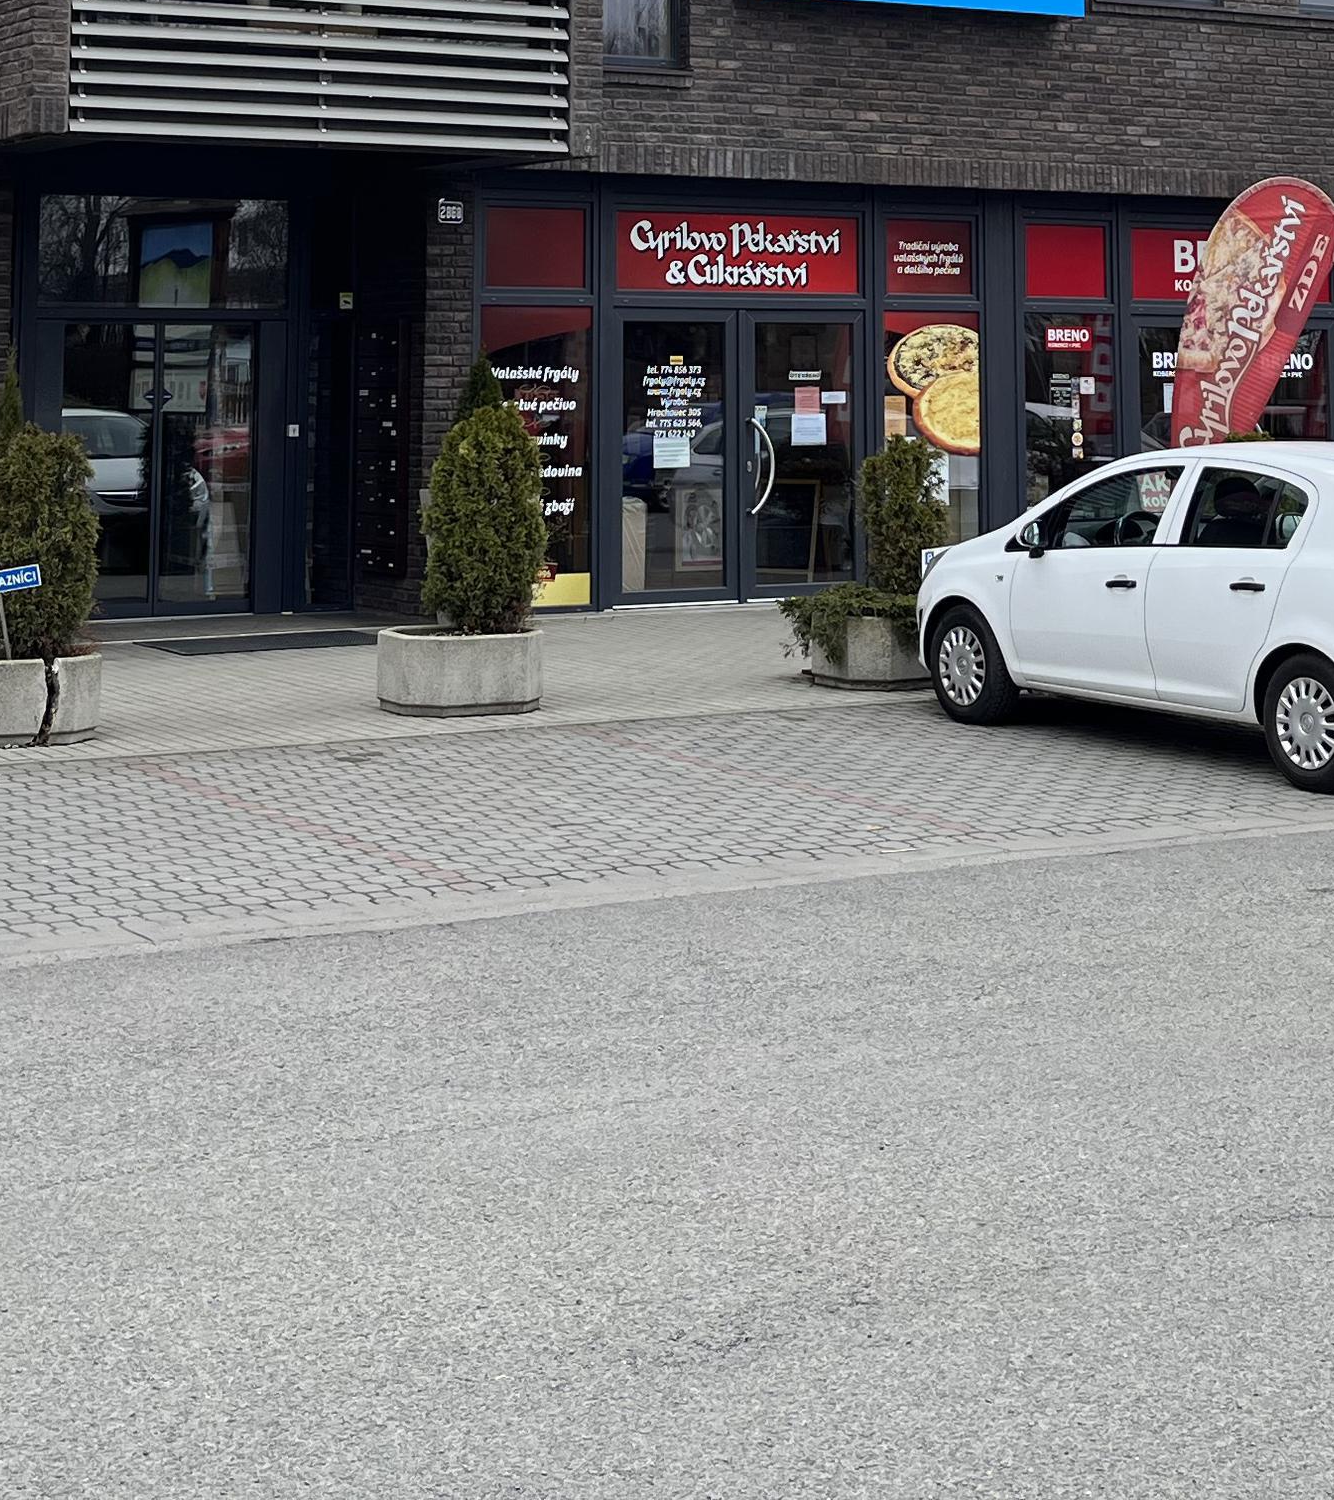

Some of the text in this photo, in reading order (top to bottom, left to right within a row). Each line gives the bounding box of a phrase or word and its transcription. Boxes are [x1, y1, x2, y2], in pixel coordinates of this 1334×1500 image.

[629, 219, 841, 260] Cyrilovo Pekařství
[665, 254, 808, 286] & Cukrářství
[1288, 233, 1331, 312] ZDE
[1047, 329, 1090, 342] BRENO
[491, 366, 579, 383] Valašské frgály
[538, 398, 577, 413] pečivo
[539, 463, 583, 479] edovina
[545, 499, 575, 516] zboží
